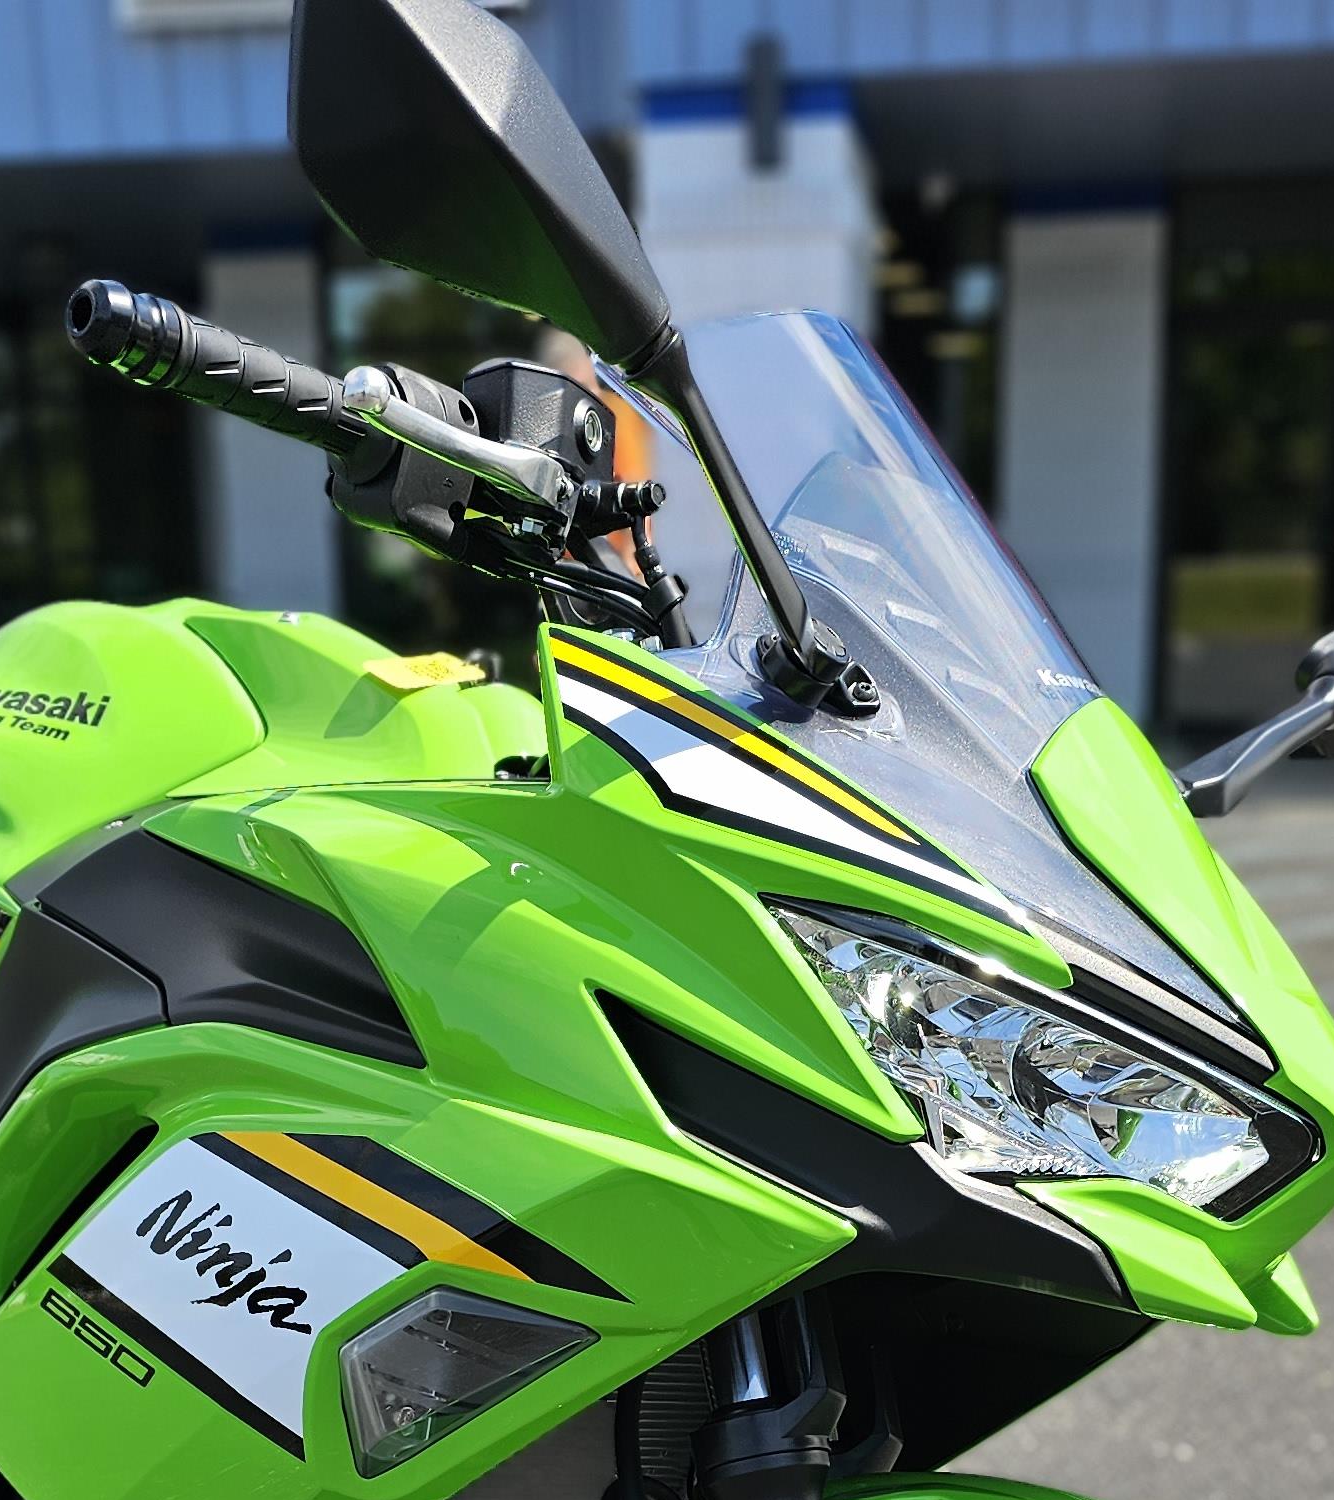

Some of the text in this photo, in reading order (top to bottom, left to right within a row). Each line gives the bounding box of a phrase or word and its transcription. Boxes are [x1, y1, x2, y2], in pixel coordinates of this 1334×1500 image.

[9, 715, 70, 741] Team
[135, 1189, 312, 1335] Ninja
[39, 1287, 156, 1388] 650
